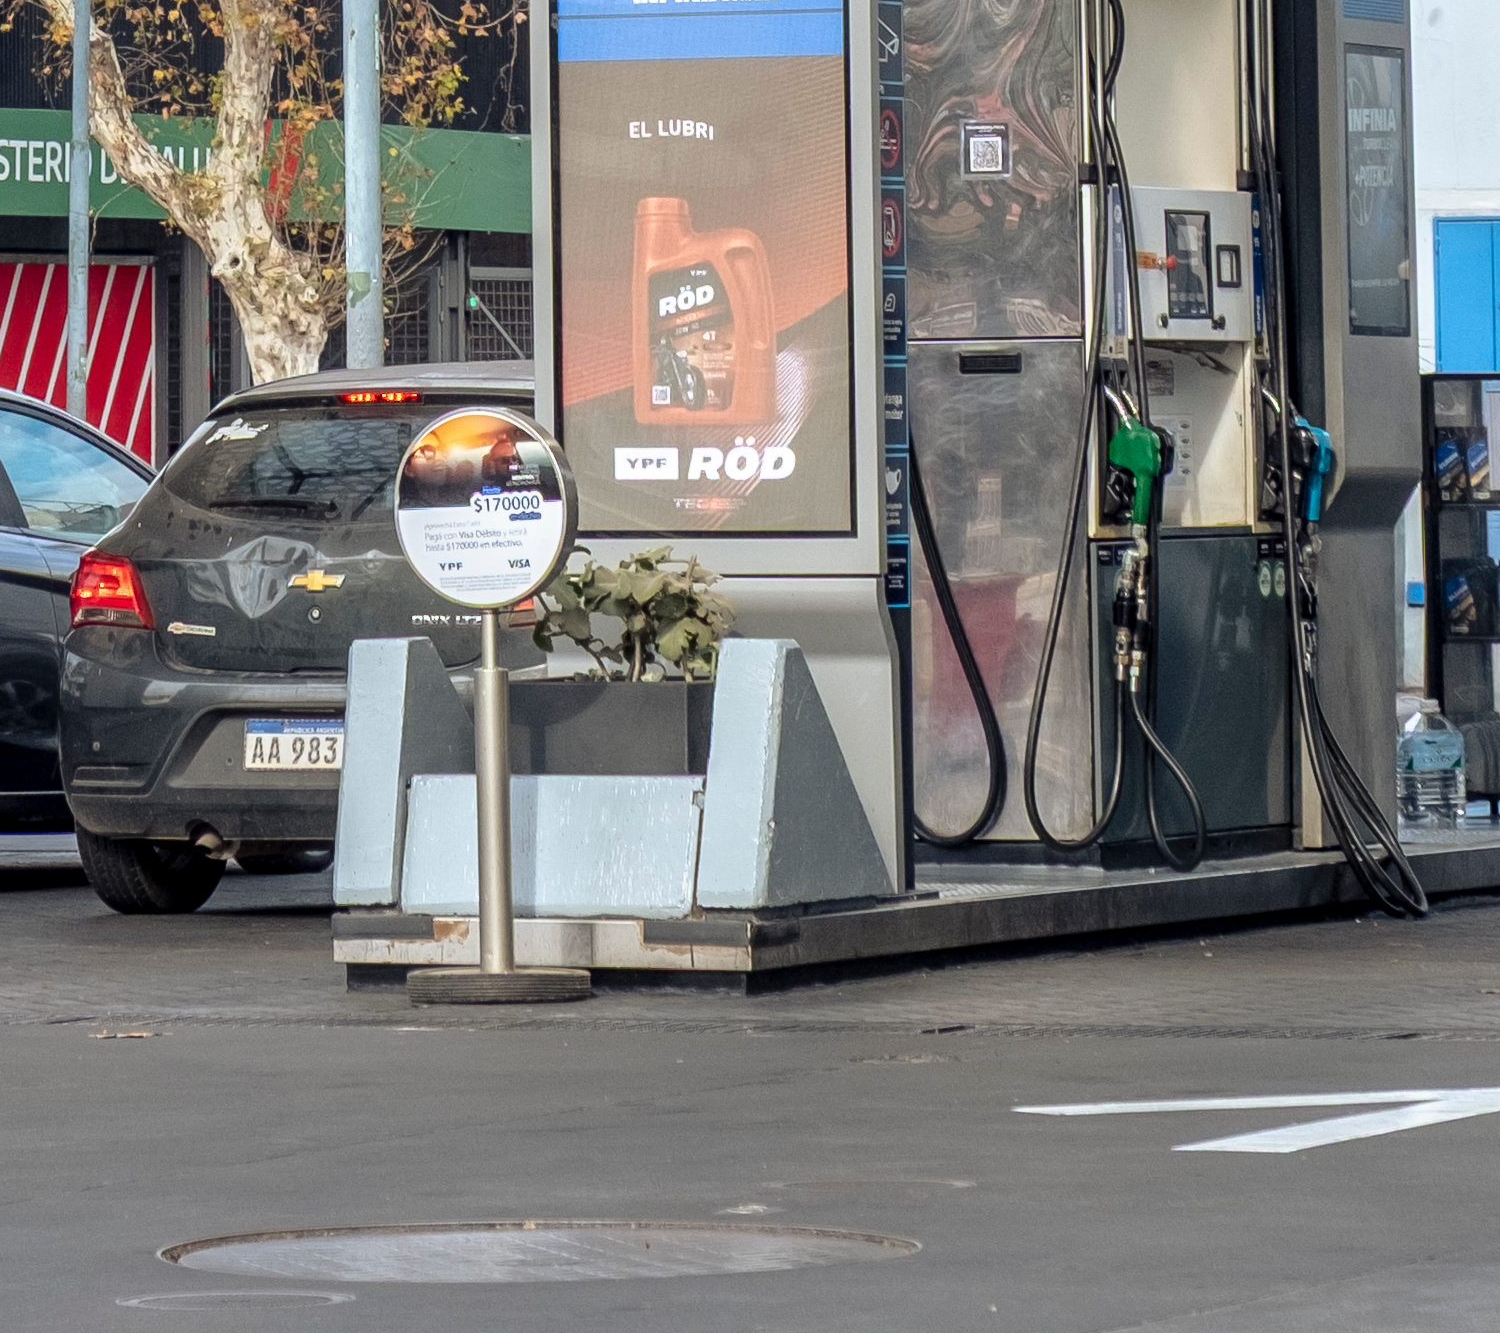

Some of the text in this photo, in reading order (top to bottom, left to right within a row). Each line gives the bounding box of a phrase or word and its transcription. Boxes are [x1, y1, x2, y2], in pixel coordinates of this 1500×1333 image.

[629, 121, 652, 138] EL
[1349, 108, 1397, 132] INFINIA
[659, 285, 714, 317] RÖD
[626, 436, 797, 480] YPF RÖD
[474, 495, 540, 513] $170000
[440, 559, 530, 571] YPF VISA
[251, 736, 338, 765] AA 983
